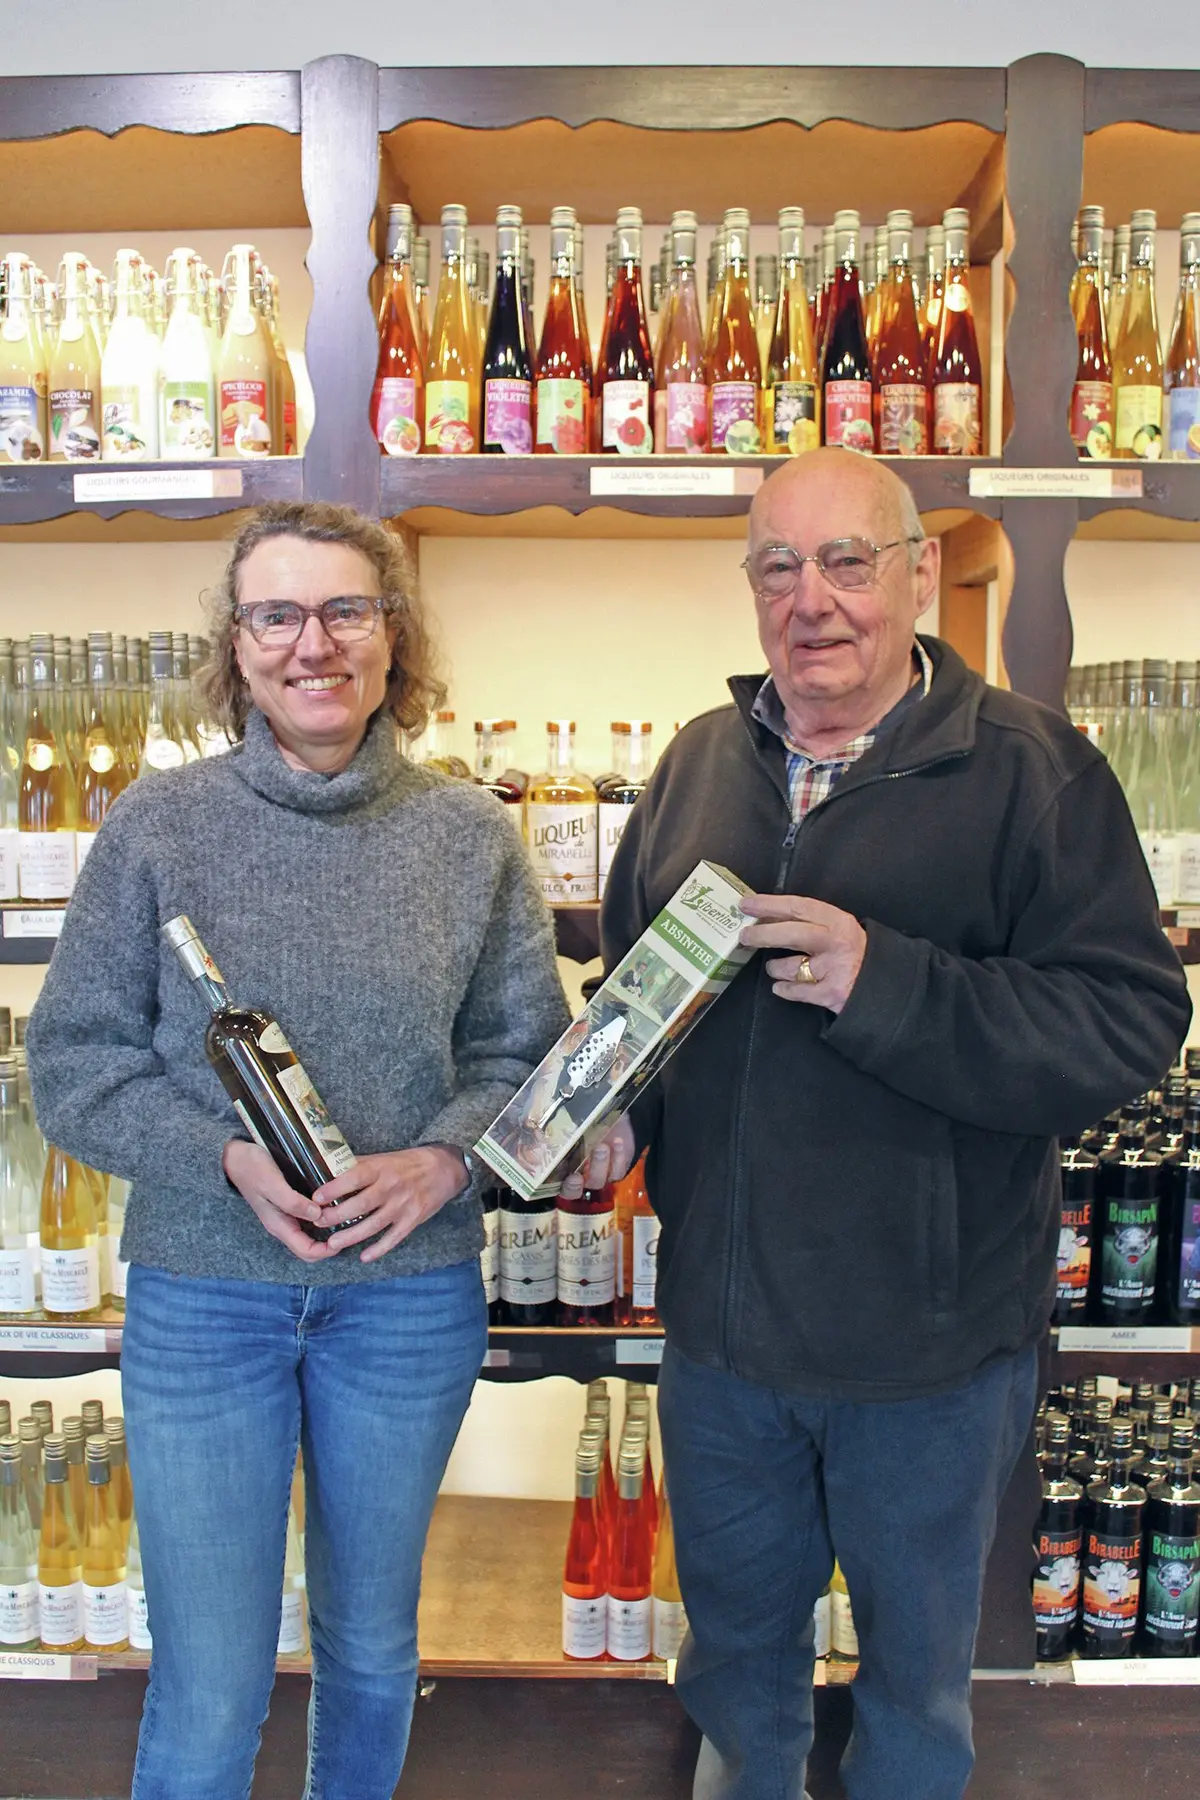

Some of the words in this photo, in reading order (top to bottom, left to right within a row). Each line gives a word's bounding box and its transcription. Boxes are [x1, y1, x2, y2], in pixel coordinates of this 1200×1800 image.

[0, 387, 31, 397] ARAMEL
[51, 390, 91, 401] CHOCOLAT
[989, 471, 1035, 481] LIQUEURS
[1036, 472, 1090, 482] ORIGINALES
[534, 812, 596, 847] LIQUEUR
[542, 883, 566, 894] ULCE
[680, 886, 738, 930] Libertine
[20, 914, 44, 924] EAUX
[660, 918, 713, 967] ABSINTHE
[1061, 1203, 1091, 1225] BELLE
[0, 1330, 11, 1338] UX
[26, 1331, 39, 1339] VIE
[41, 1331, 89, 1340] CLASSIQUES
[1089, 1534, 1141, 1560] BIRABELLE
[1152, 1535, 1200, 1560] BIRSAPIN
[8, 1657, 55, 1666] CLASSIQUES
